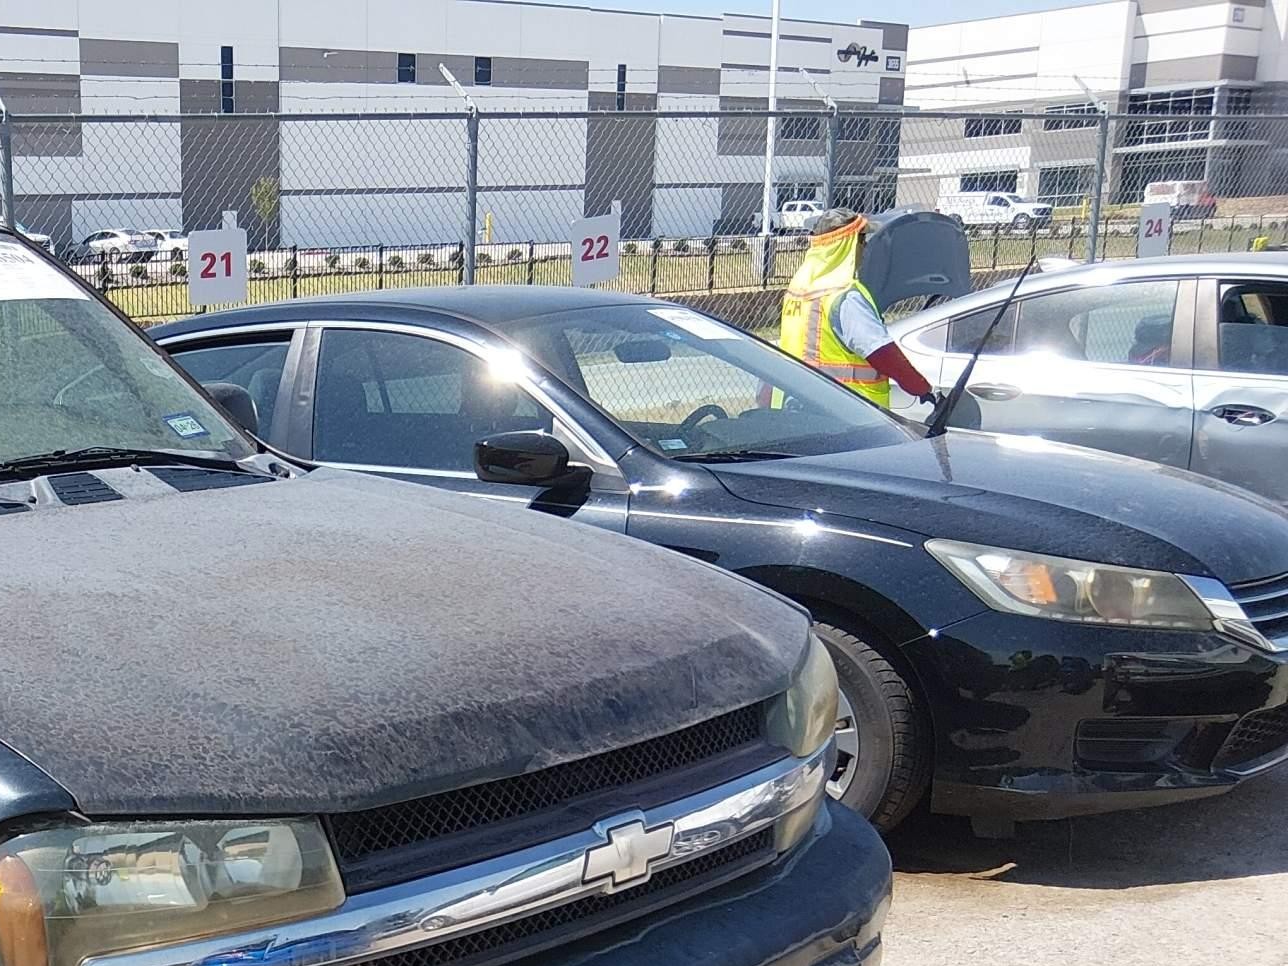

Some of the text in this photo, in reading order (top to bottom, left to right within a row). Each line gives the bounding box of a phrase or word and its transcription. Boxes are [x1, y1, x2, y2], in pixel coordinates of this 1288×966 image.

[1144, 218, 1163, 238] 24
[581, 235, 609, 262] 22
[200, 252, 231, 278] 21
